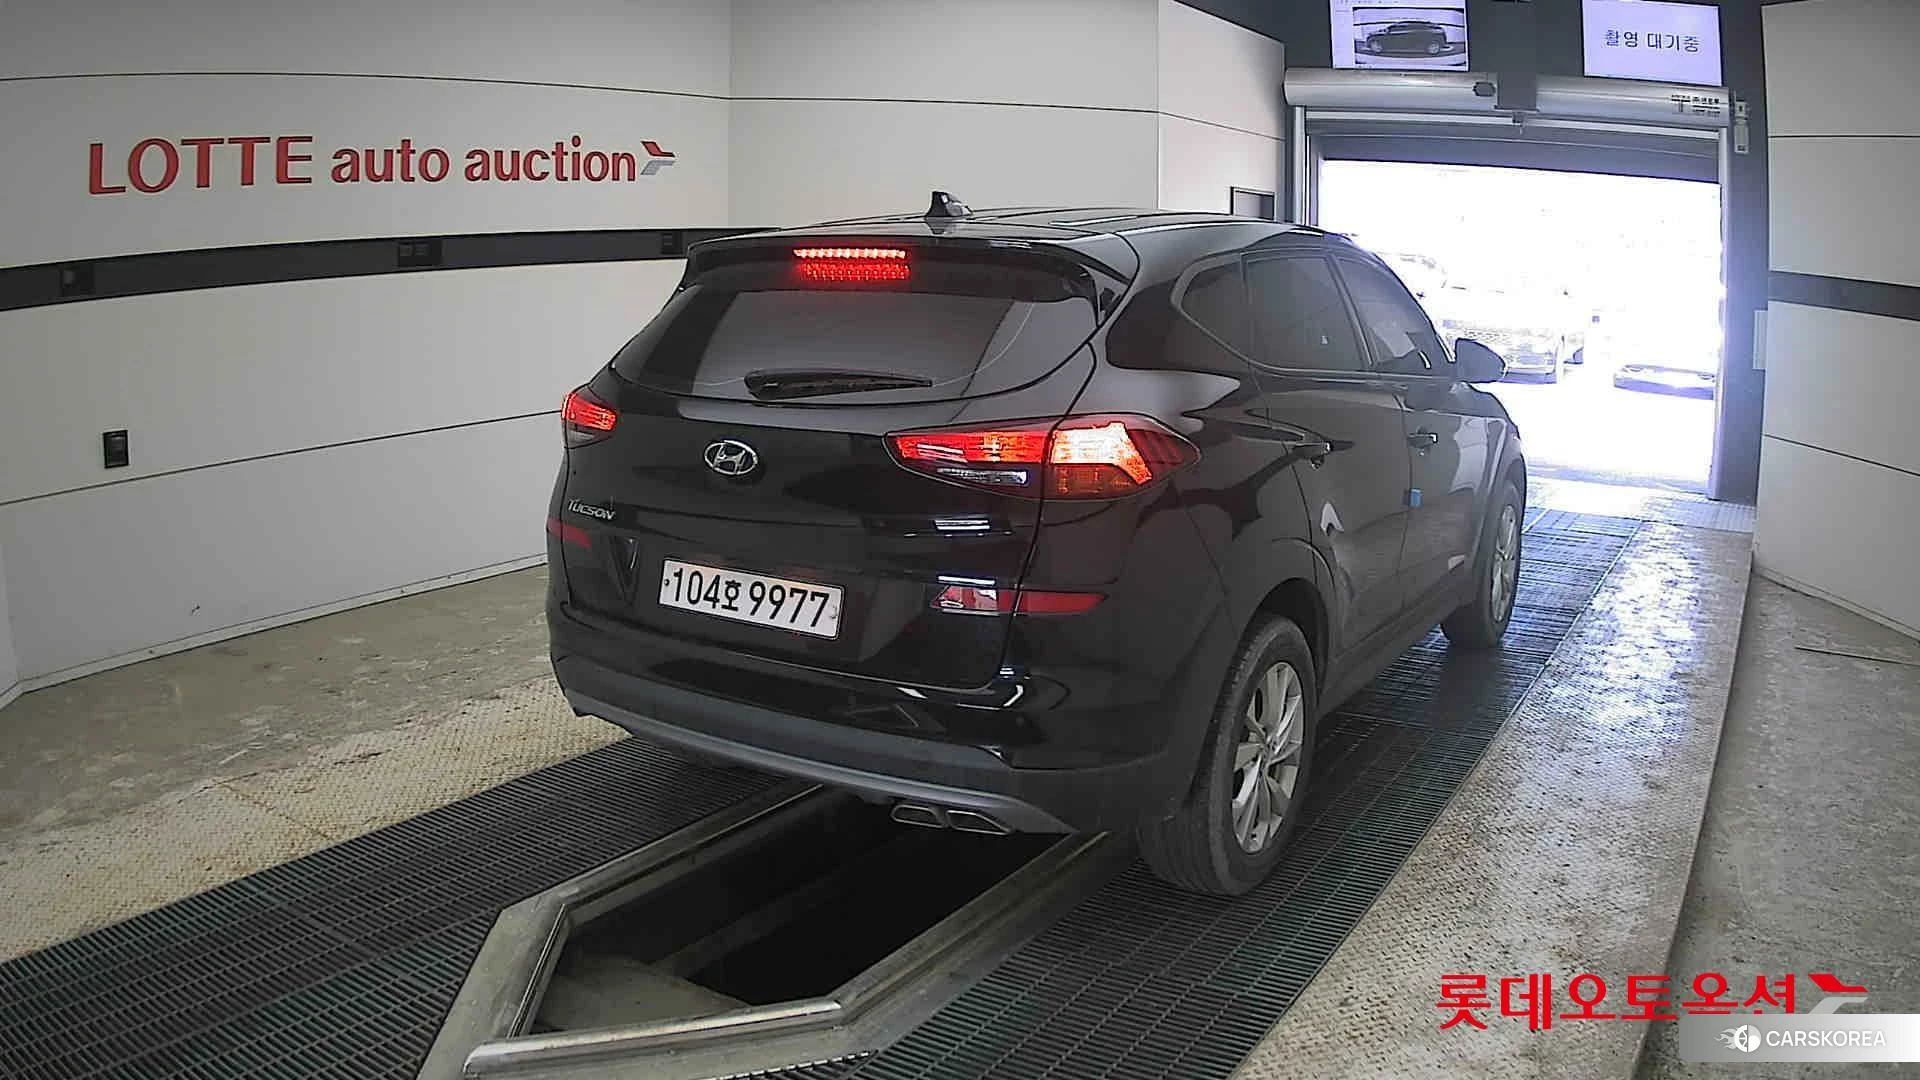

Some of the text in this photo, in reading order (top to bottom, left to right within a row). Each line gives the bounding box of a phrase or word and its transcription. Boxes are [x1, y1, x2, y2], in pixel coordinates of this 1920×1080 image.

[1647, 33, 1699, 53] 대기중
[89, 136, 636, 194] LOTTE auto auction
[568, 498, 616, 520] TUCSON
